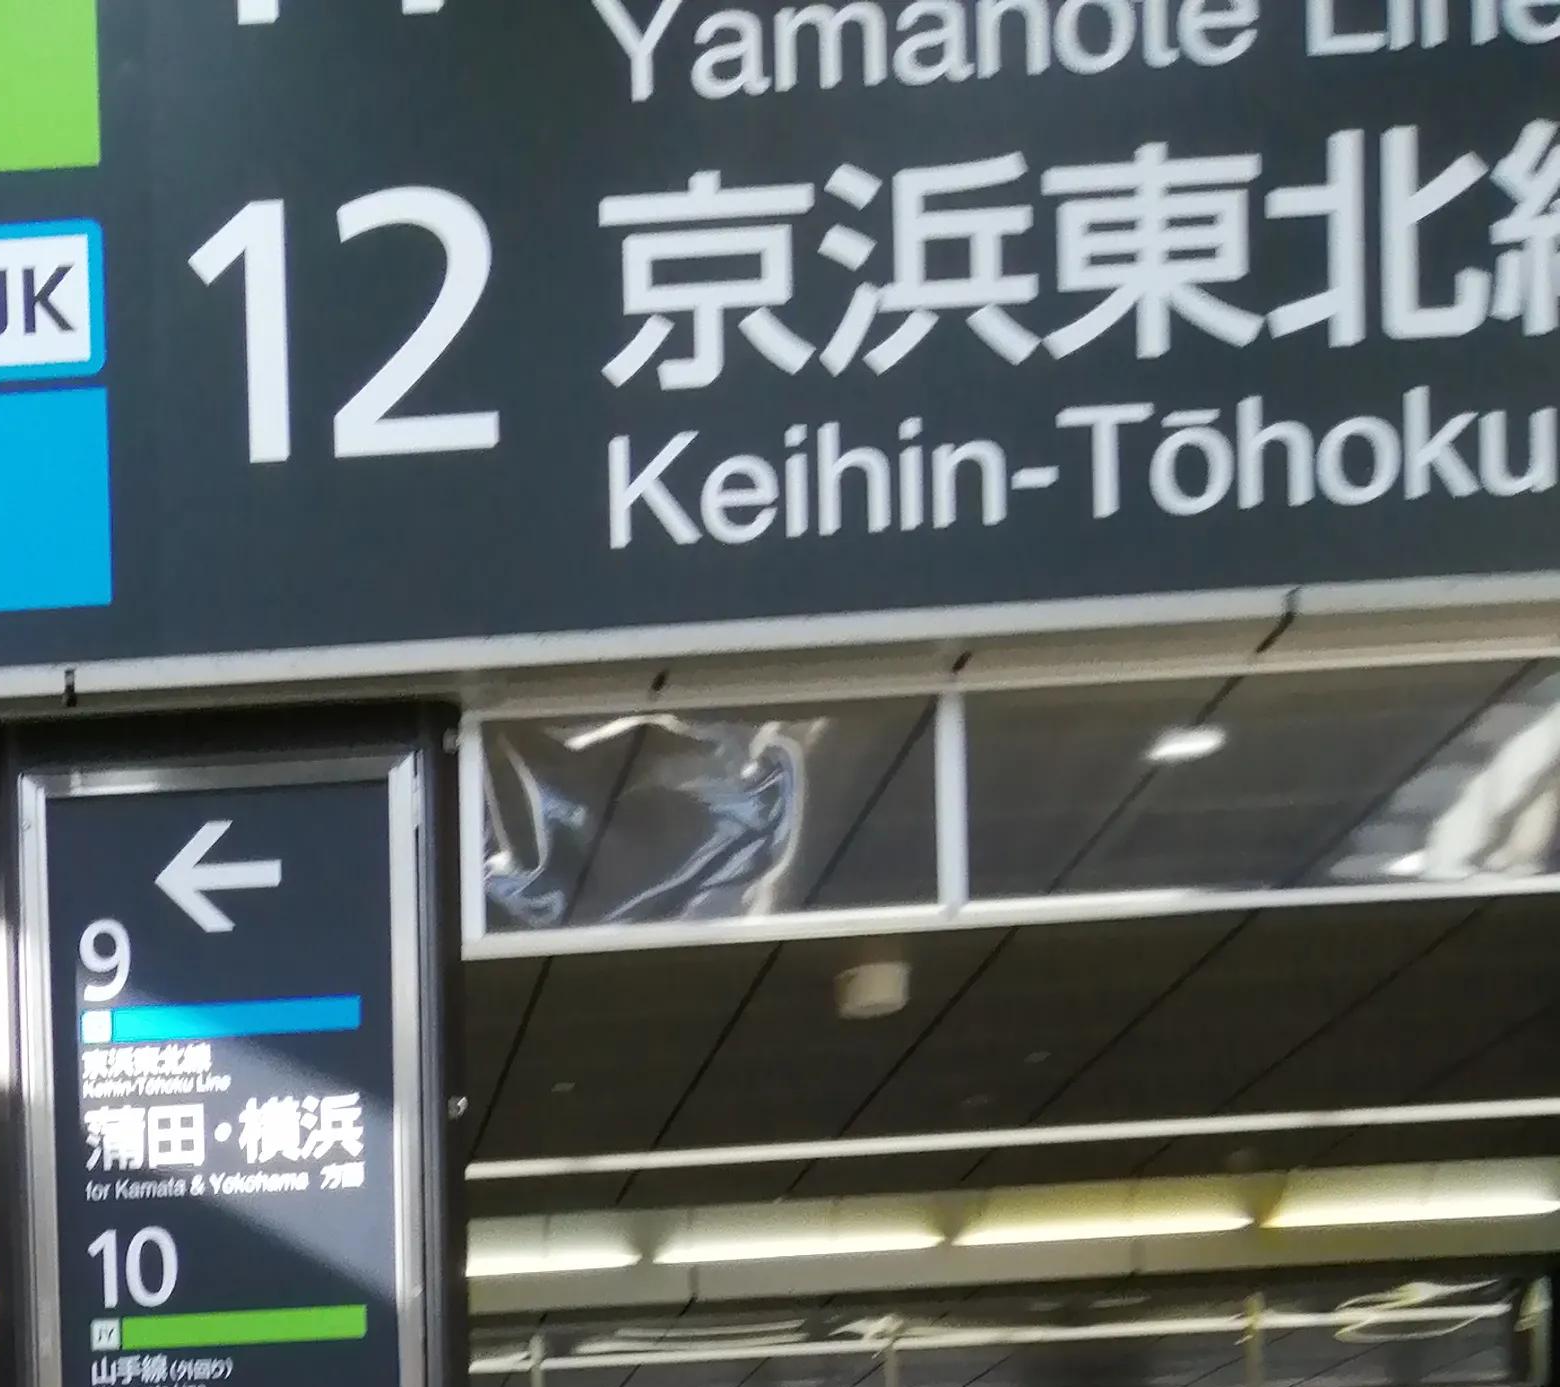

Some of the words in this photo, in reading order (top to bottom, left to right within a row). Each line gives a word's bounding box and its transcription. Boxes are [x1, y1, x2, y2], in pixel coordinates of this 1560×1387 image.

[187, 185, 502, 464] 12
[607, 386, 1558, 551] Keihin-Tōhoku
[79, 918, 132, 1002] 9
[83, 1092, 365, 1172] 蒲田・横浜
[85, 1181, 110, 1201] for
[114, 1176, 188, 1200] Kamata
[190, 1175, 205, 1197] &
[208, 1171, 310, 1196] Yokohama
[86, 1225, 178, 1309] 10
